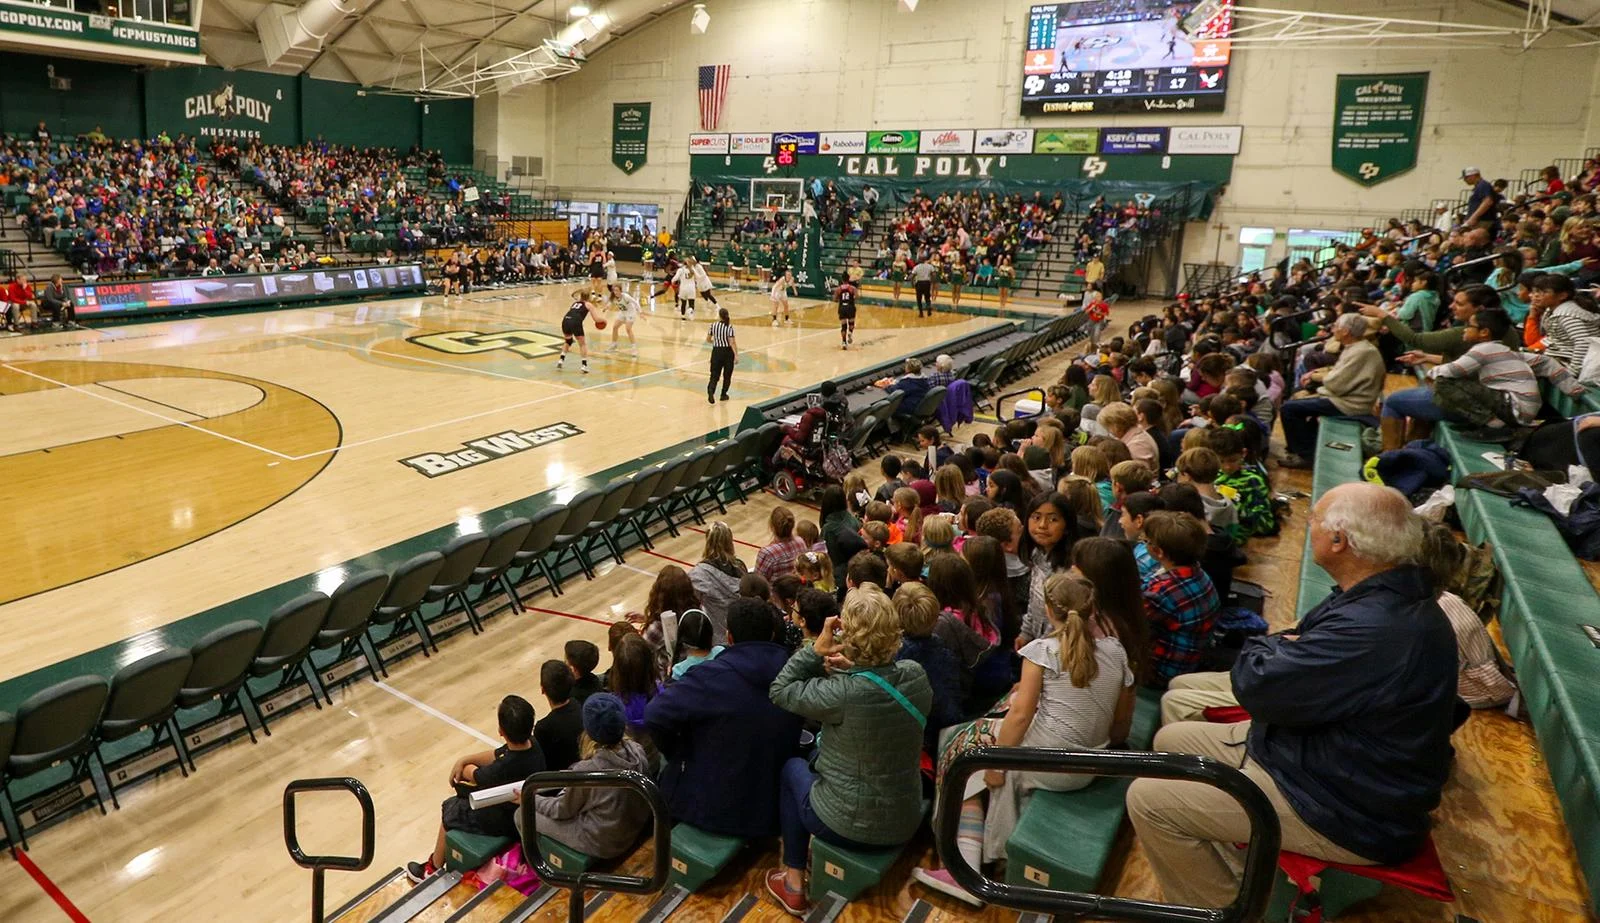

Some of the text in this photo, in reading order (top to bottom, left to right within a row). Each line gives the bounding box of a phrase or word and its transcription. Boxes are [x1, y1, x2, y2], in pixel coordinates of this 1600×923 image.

[0, 11, 83, 32] GOPOLY.COM
[112, 26, 197, 48] #CPMUSTANGS
[1106, 70, 1132, 80] 4:18
[1054, 83, 1070, 93] 20
[1169, 78, 1187, 89] 17
[276, 89, 282, 101] 4
[185, 94, 272, 123] CAL POLY
[200, 128, 261, 139] MUSTANGS
[882, 133, 904, 142] slime
[1136, 133, 1161, 142] NEWS
[690, 138, 727, 146] SUPERCUTS
[744, 136, 770, 144] IDLER'S
[832, 139, 864, 147] Rabobank
[778, 151, 793, 164] 26
[837, 155, 844, 167] 7
[999, 155, 1006, 167] 8
[847, 157, 992, 175] CAL POLY
[97, 283, 142, 296] IDLER'S
[99, 292, 136, 305] HOME
[841, 292, 850, 300] 12
[398, 421, 585, 478] BIG WEST
